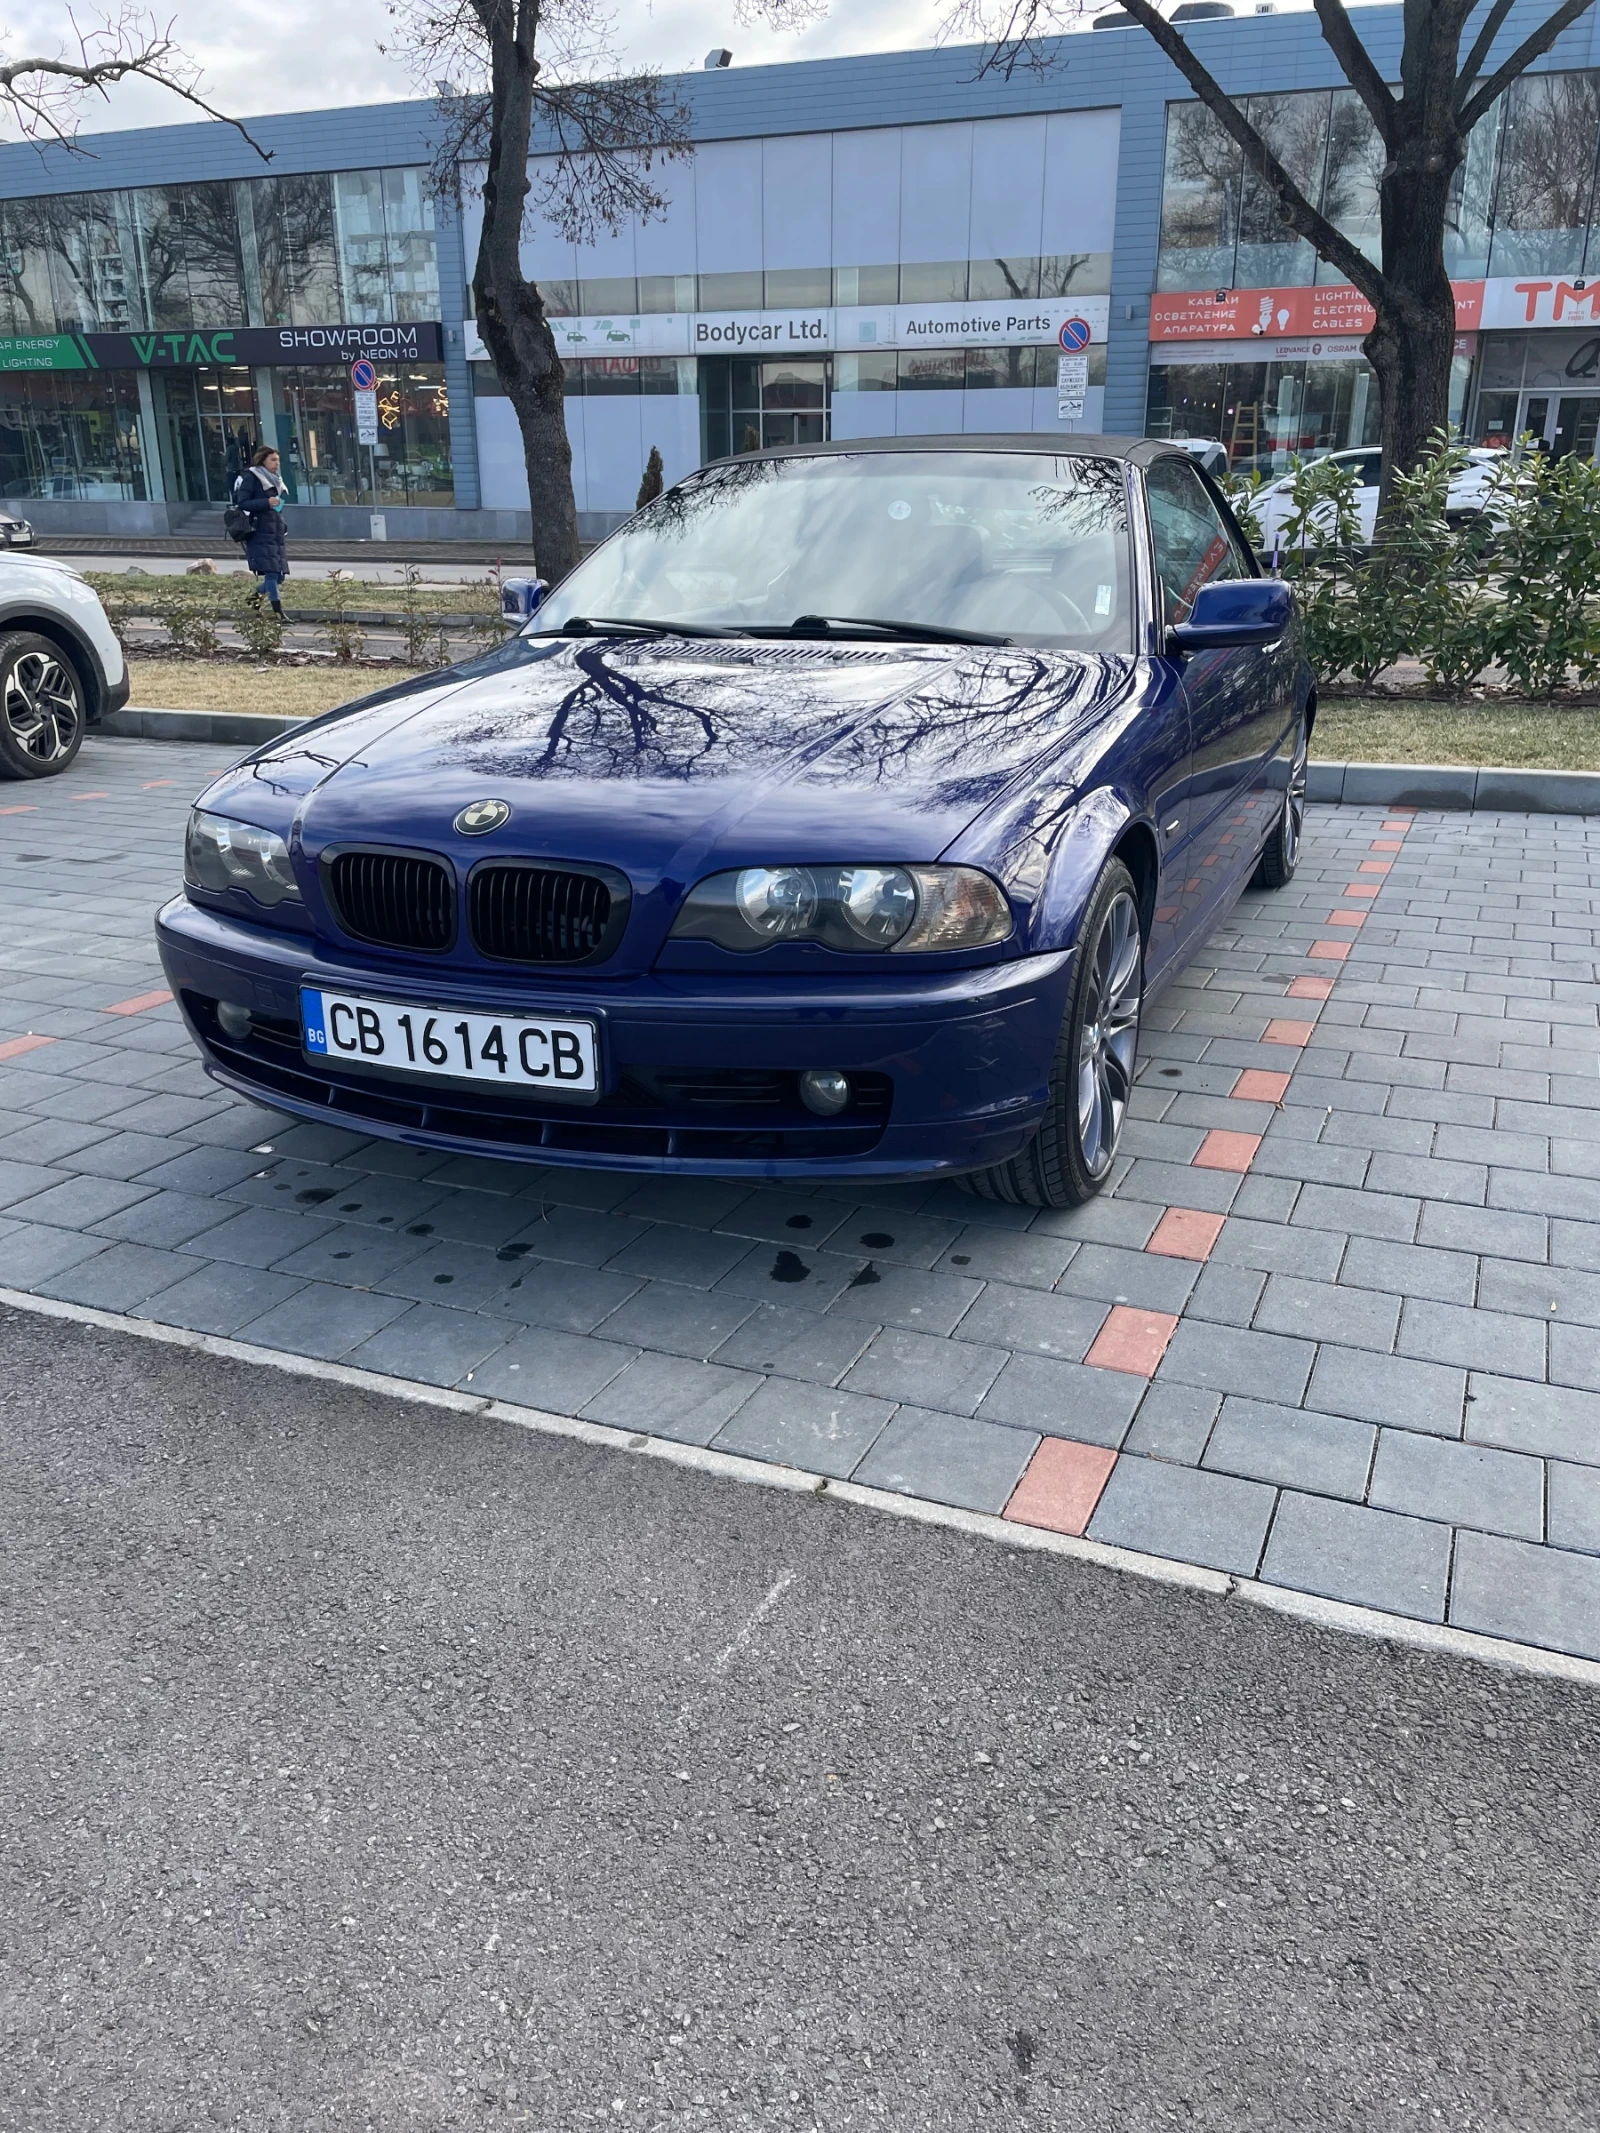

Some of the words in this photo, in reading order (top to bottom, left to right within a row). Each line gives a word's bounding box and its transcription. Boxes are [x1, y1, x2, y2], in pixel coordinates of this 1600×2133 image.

[1314, 291, 1366, 302] LIGHTIN
[1154, 310, 1237, 322] ОСВЕТЛЕНИЕ
[906, 318, 1001, 336] Automotive
[1006, 316, 1051, 332] Parts
[1163, 323, 1236, 334] АПАРАТУРА
[1312, 318, 1363, 329] CABLES
[279, 326, 418, 348] SHOWROOM
[696, 322, 782, 345] Bodycar
[788, 319, 828, 340] Ltd.
[16, 339, 60, 350] ENERGY
[130, 332, 237, 364] V-TAC
[1275, 346, 1311, 354] LEDVANCE
[1327, 344, 1358, 353] OSRAM
[341, 350, 355, 362] by
[360, 348, 399, 360] NEON
[401, 347, 419, 359] 10
[2, 357, 53, 368] LIGHTING
[307, 1028, 325, 1044] BG
[330, 1003, 385, 1056] CB
[397, 1014, 508, 1074] 1614
[518, 1028, 585, 1081] CB
